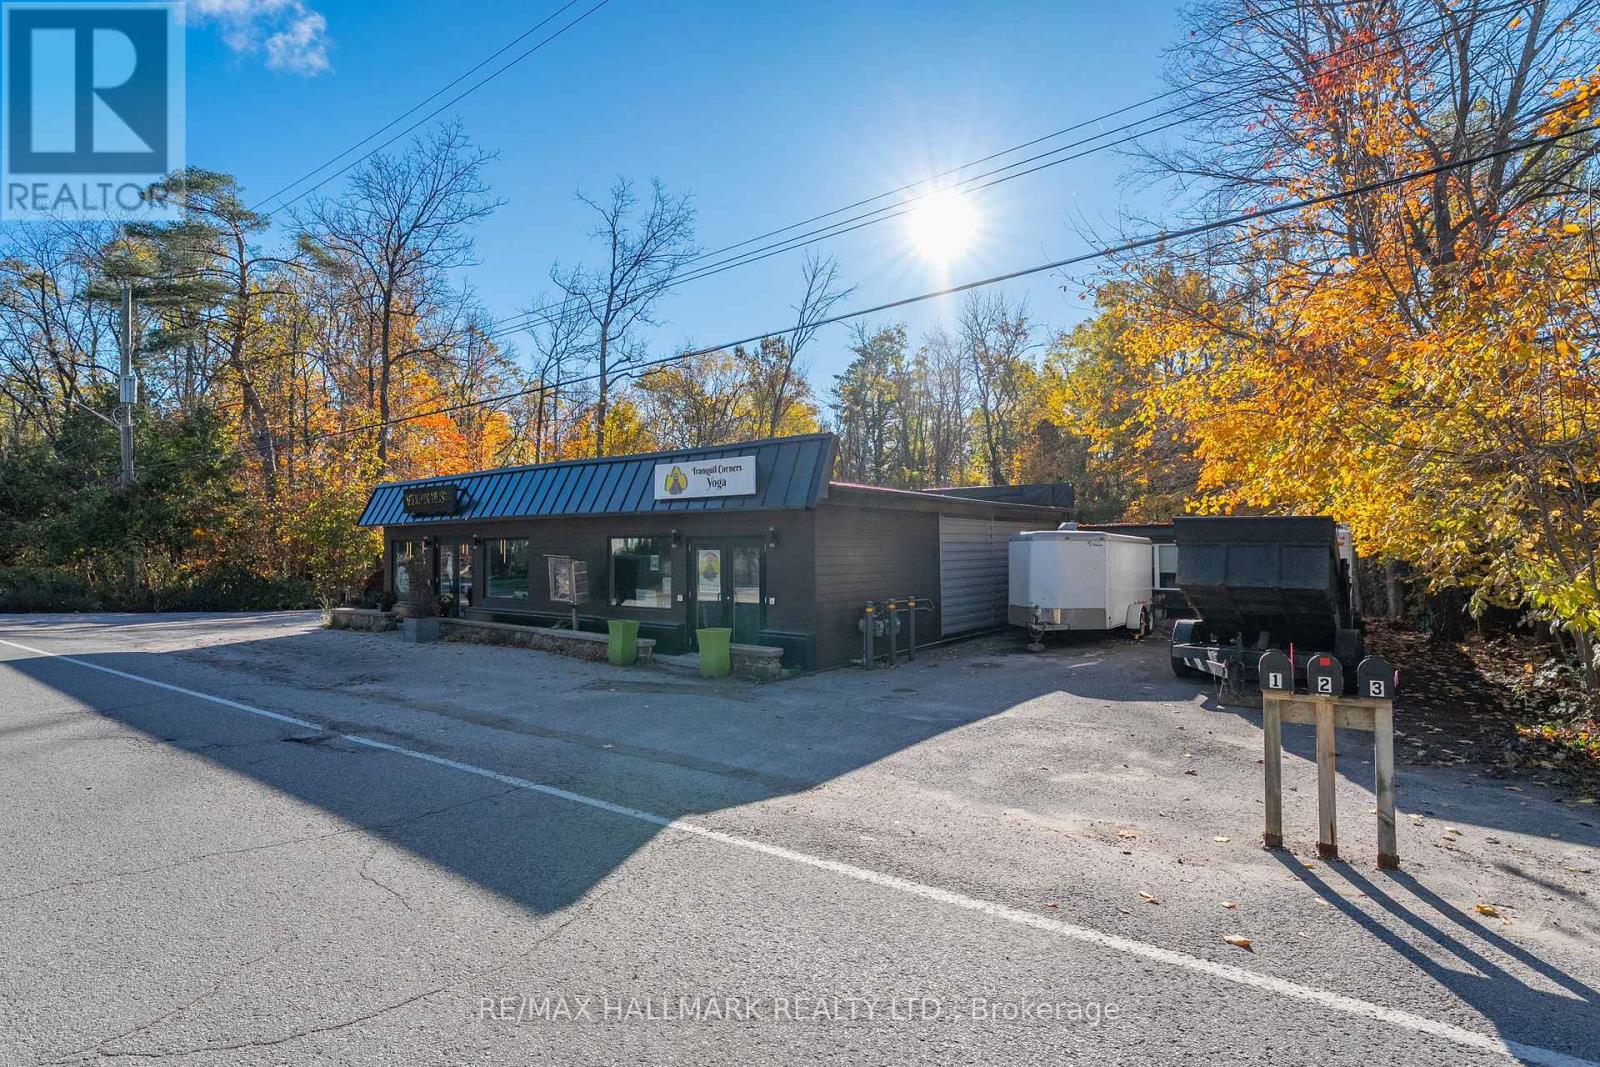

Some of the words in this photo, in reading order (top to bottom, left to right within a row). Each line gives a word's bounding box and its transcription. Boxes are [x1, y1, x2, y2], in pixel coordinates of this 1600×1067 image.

[692, 465, 717, 476] Tranquil
[718, 464, 742, 474] Corners
[706, 477, 727, 490] Yoga
[1271, 674, 1280, 687] 1
[1319, 678, 1330, 691] 2
[1371, 681, 1383, 695] 3
